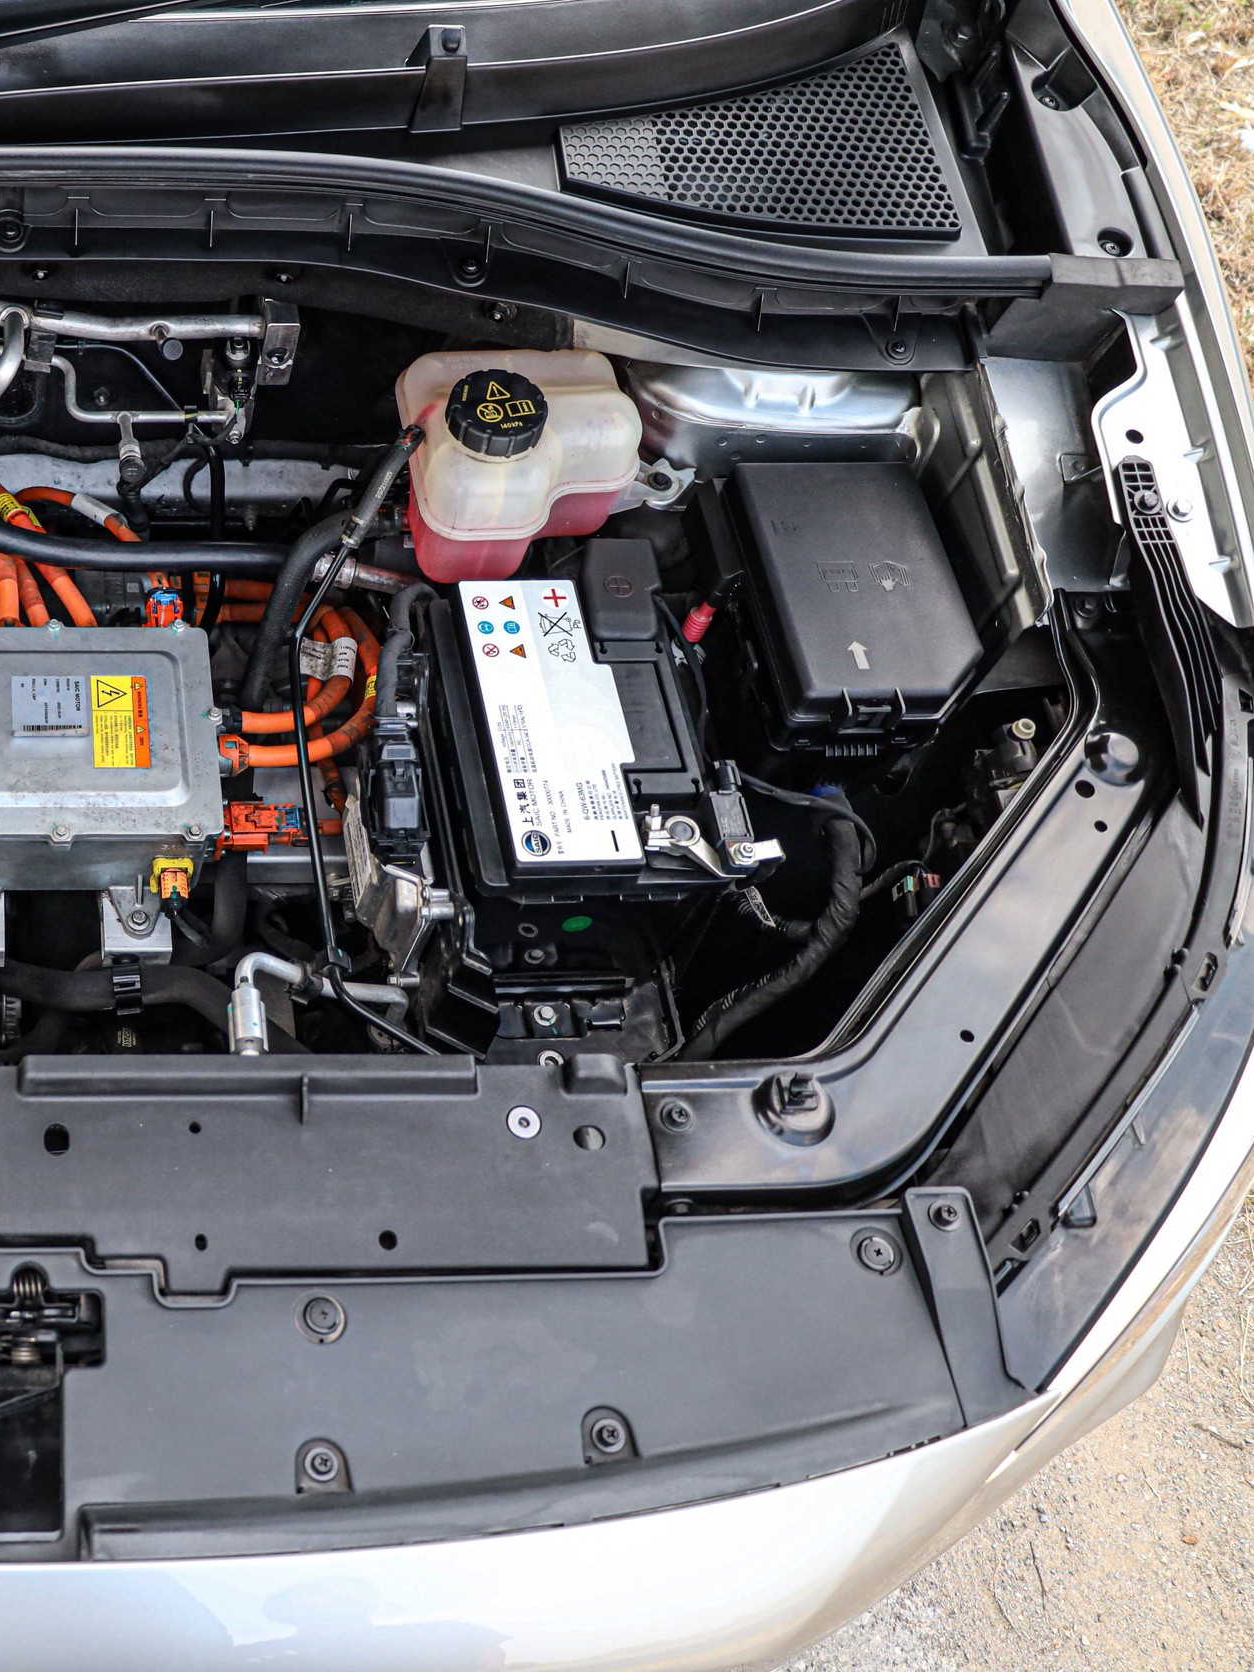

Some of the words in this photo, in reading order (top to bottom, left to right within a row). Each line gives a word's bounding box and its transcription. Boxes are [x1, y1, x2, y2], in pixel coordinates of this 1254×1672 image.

[573, 619, 582, 629] Pb
[526, 778, 538, 807] MOTOR
[543, 780, 553, 806] 30000774
[558, 791, 566, 808] CHINA
[575, 782, 591, 820] 6-QW-63MG
[513, 778, 535, 827] 上汽集团
[533, 808, 542, 827] SAIC
[564, 818, 572, 833] MADE
[552, 821, 560, 837] PART
[532, 833, 542, 853] SAIC
